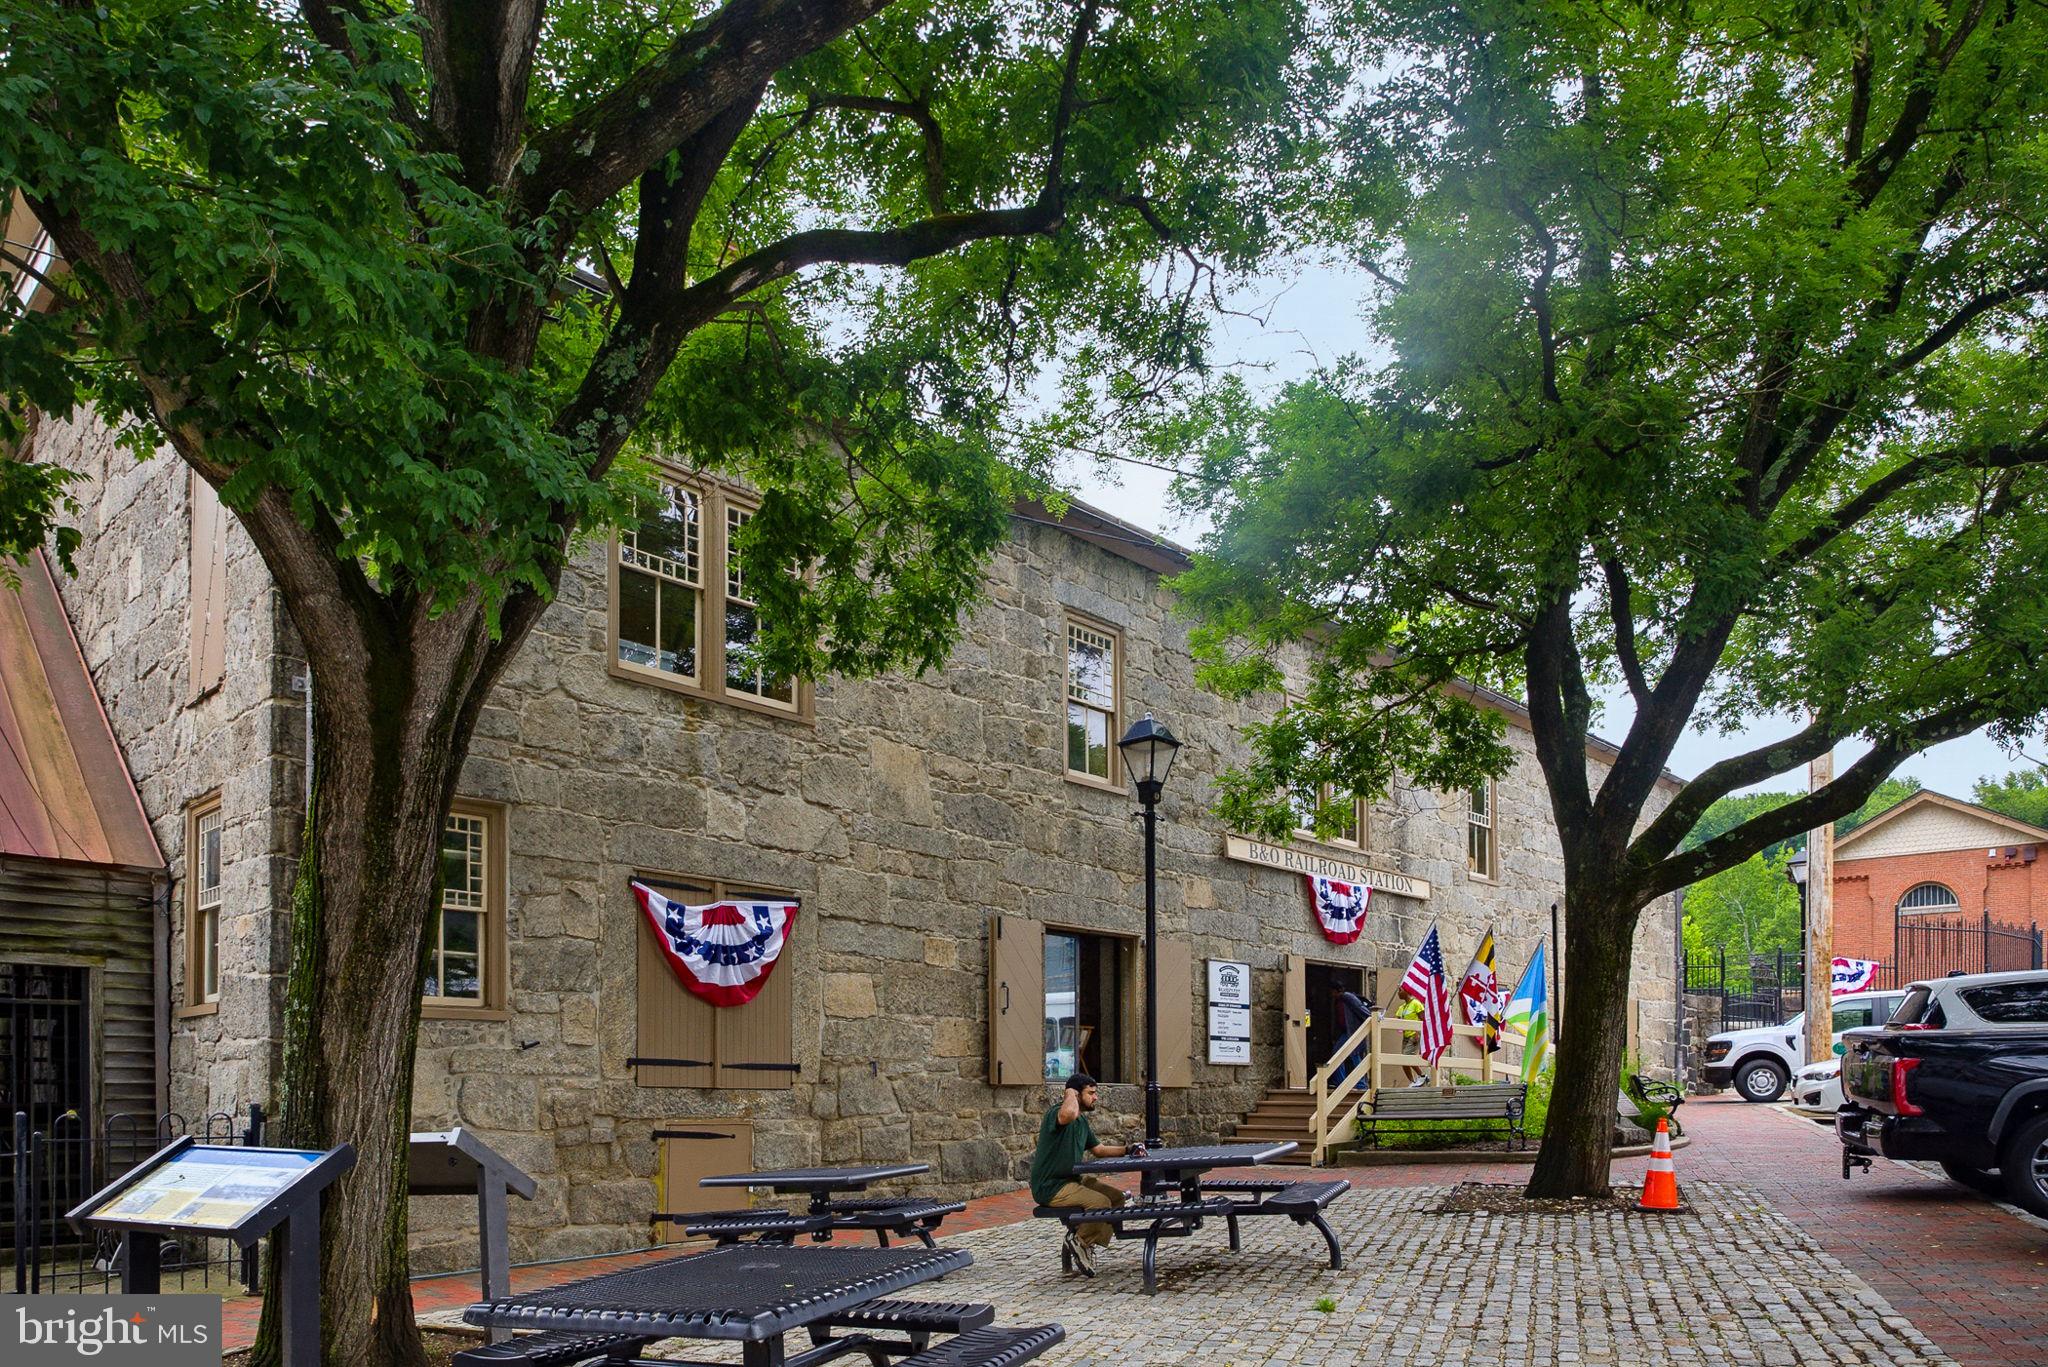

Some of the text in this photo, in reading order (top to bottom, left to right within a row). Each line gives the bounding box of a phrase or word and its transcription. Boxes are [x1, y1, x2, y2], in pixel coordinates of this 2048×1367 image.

[1249, 843, 1413, 893] B&O RAILROAD STATION
